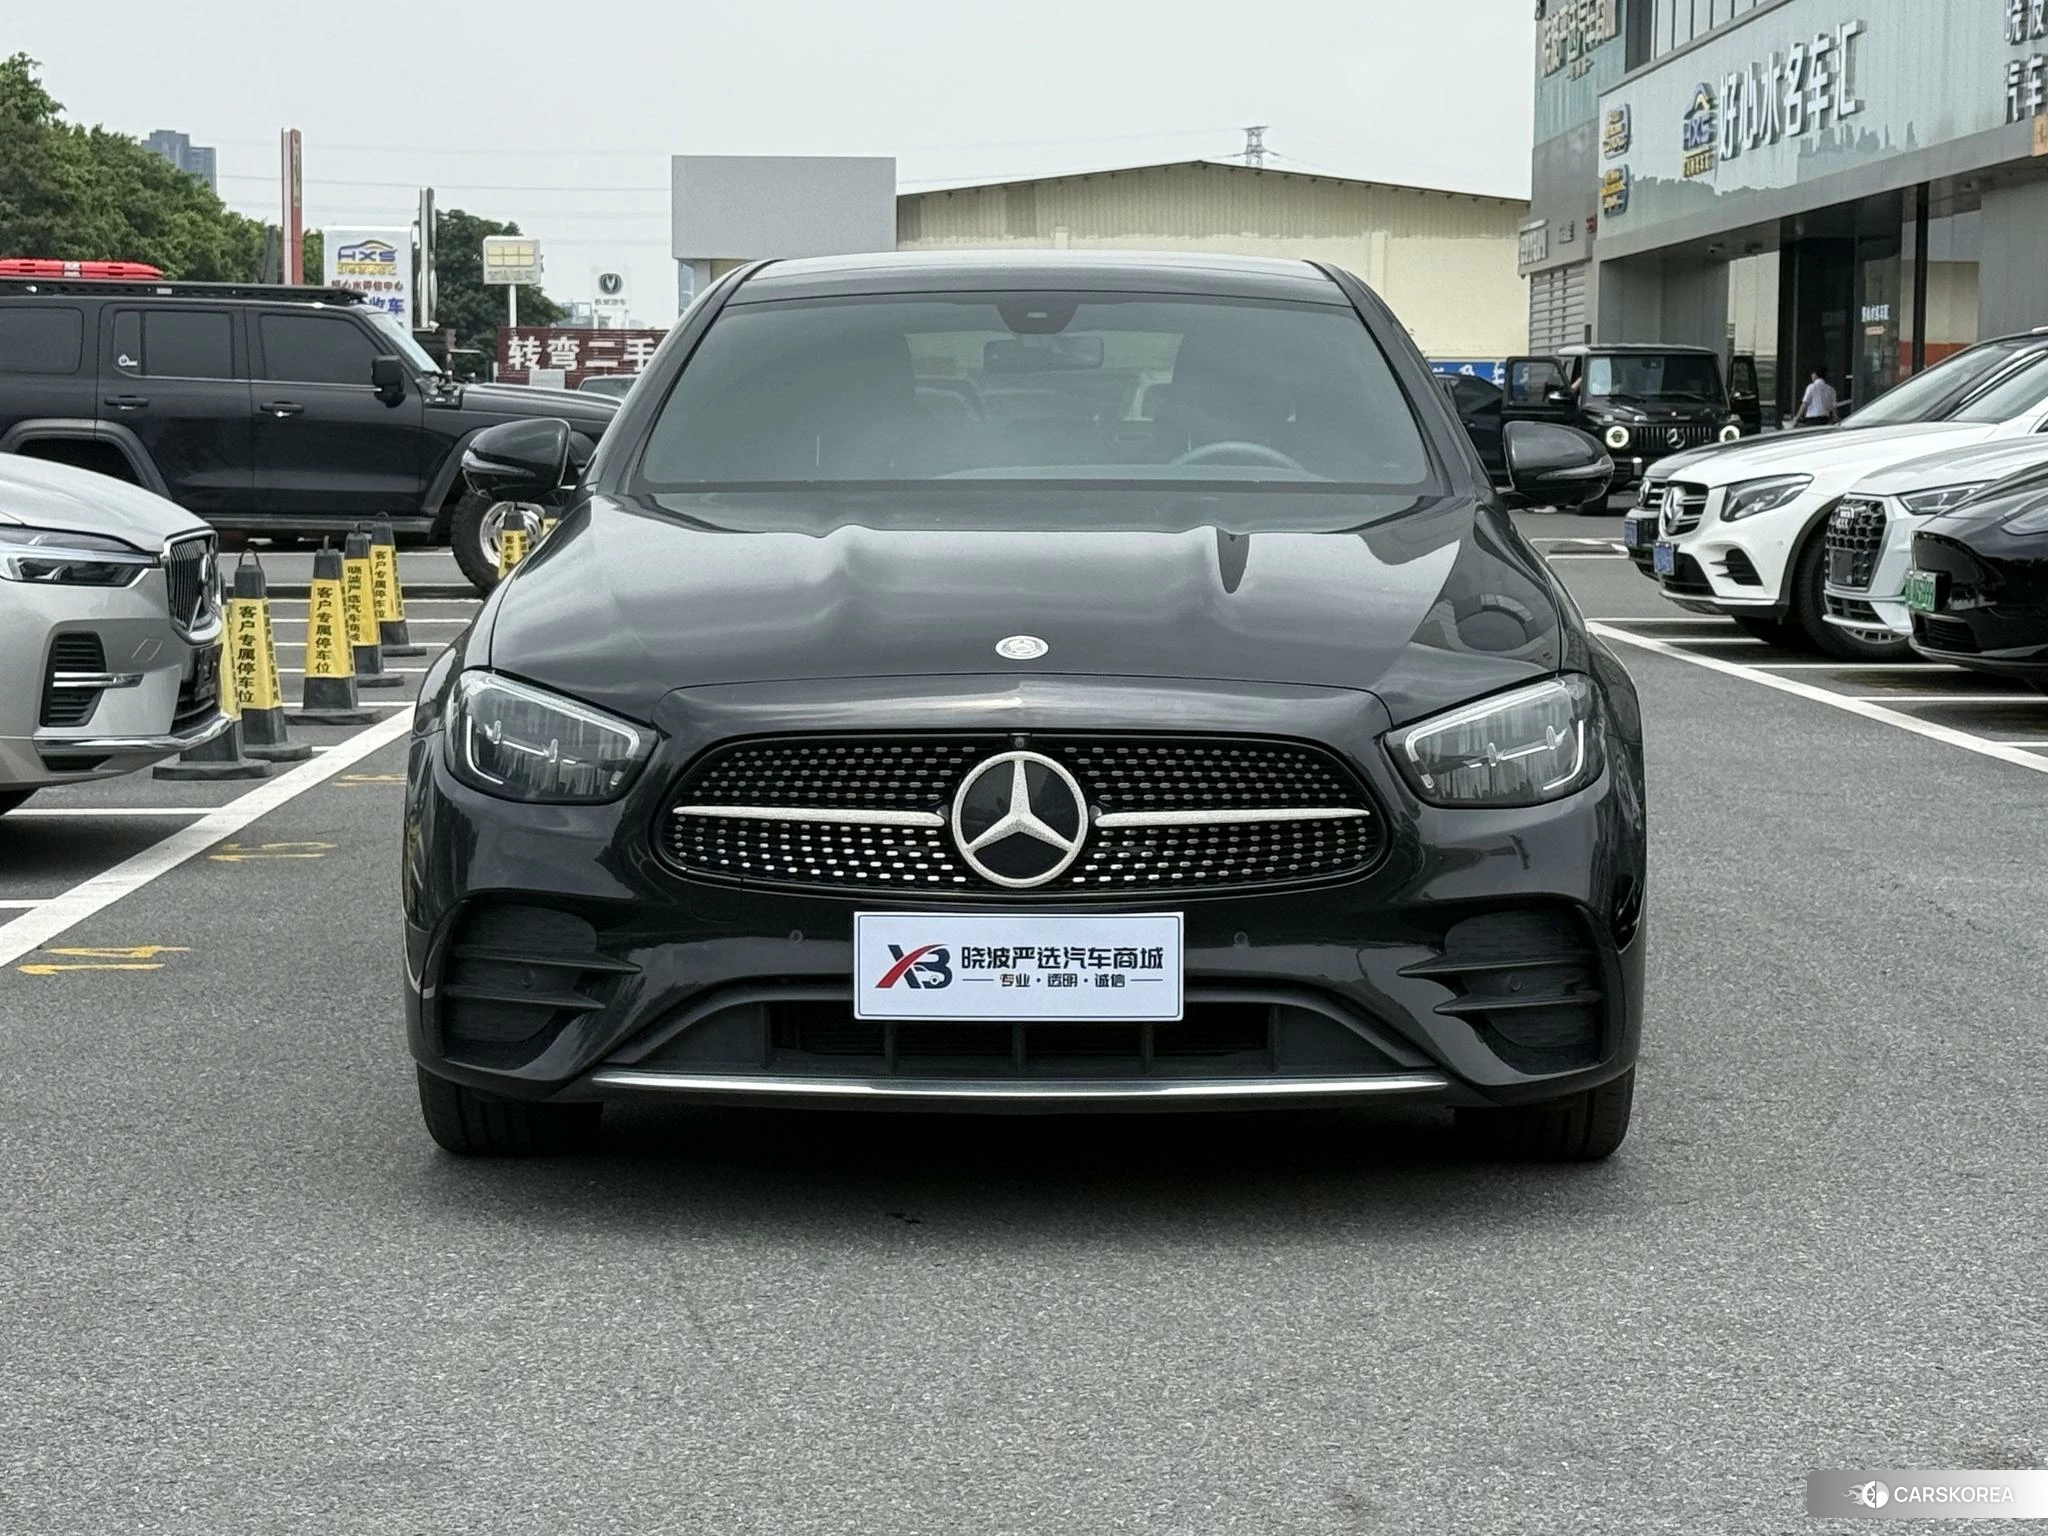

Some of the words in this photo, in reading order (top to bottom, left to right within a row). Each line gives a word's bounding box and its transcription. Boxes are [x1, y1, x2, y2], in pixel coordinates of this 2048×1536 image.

[1718, 21, 1858, 159] 好心水名车汇
[338, 247, 397, 262] HXS
[508, 335, 657, 372] 转弯二手
[375, 551, 387, 618] 客户专属停车位
[237, 605, 257, 703] 客户专属停车位
[315, 586, 333, 674] 客户专属停车位
[961, 946, 1164, 970] 晓波严选汽车商城
